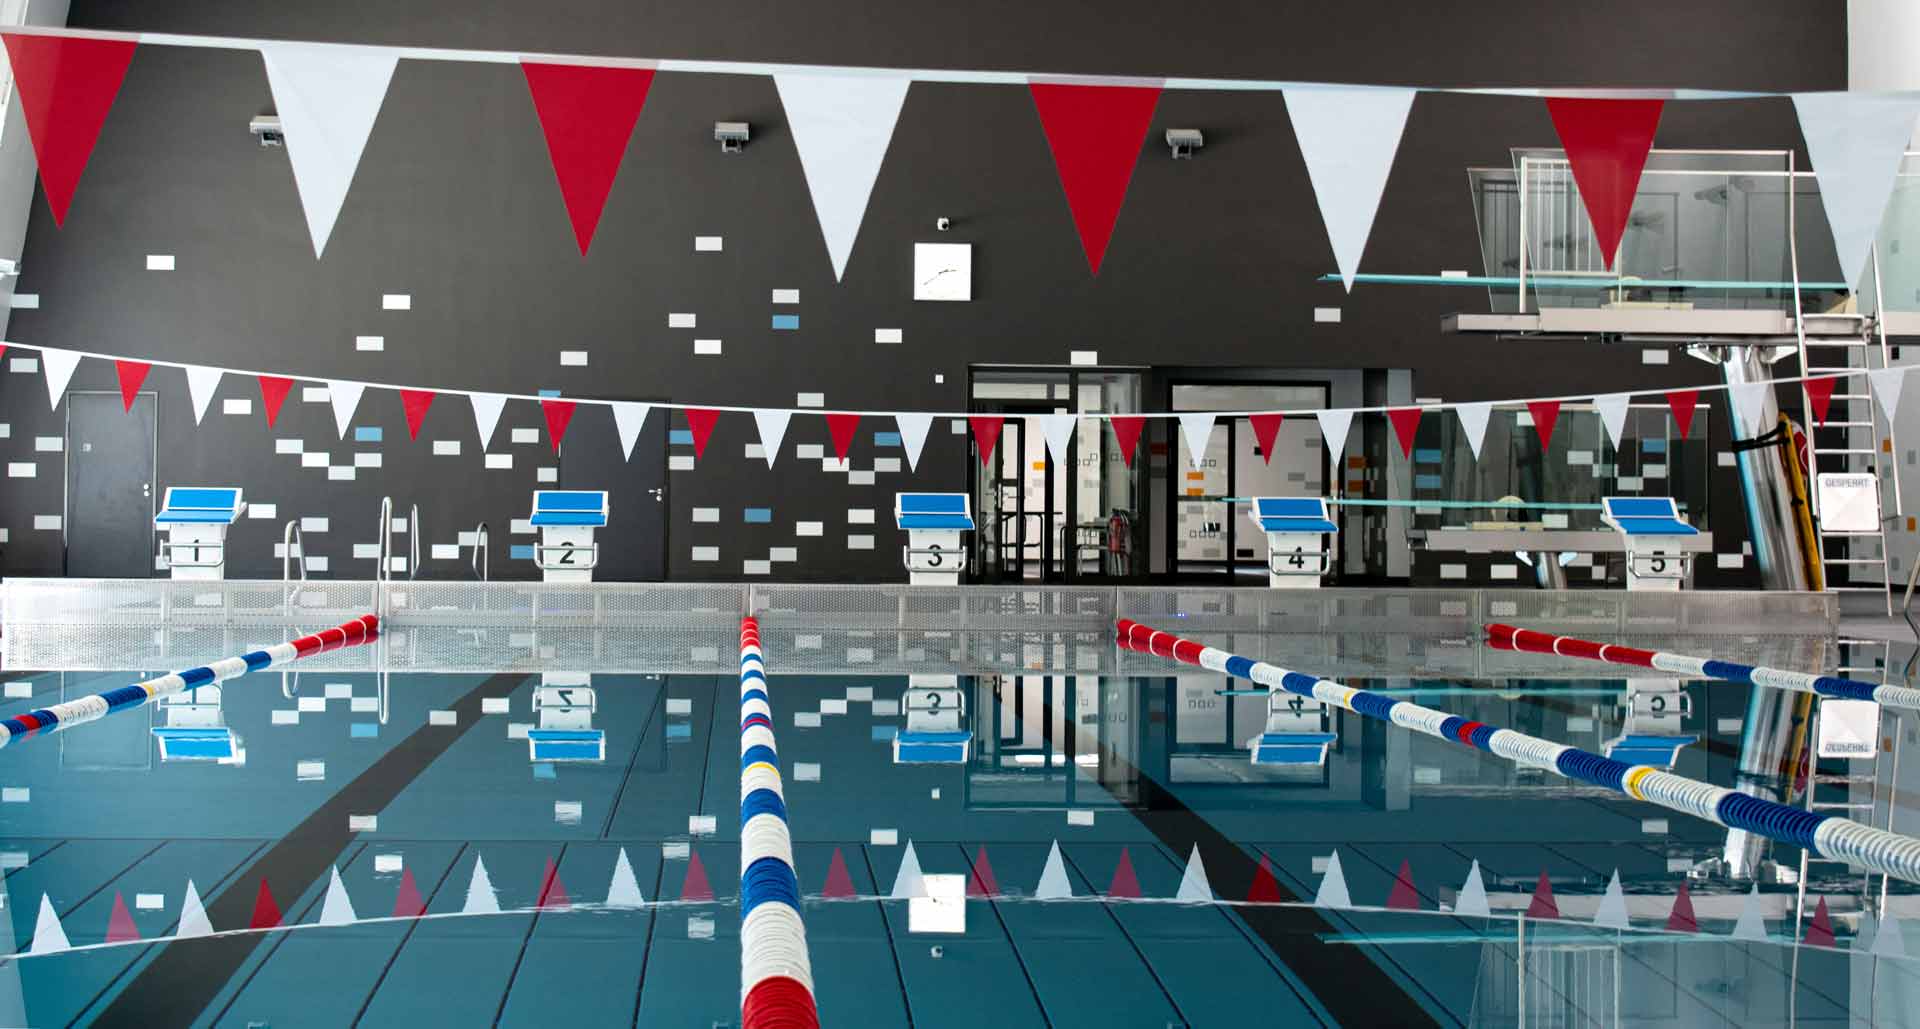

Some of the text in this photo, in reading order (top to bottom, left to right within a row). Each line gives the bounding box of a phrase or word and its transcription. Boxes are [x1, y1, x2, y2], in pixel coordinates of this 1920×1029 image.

[1825, 478, 1869, 488] GESPERRT
[193, 538, 200, 562] 1
[559, 542, 575, 564] 2
[927, 544, 943, 567] 3
[1288, 546, 1305, 569] 4
[1650, 550, 1667, 573] 5
